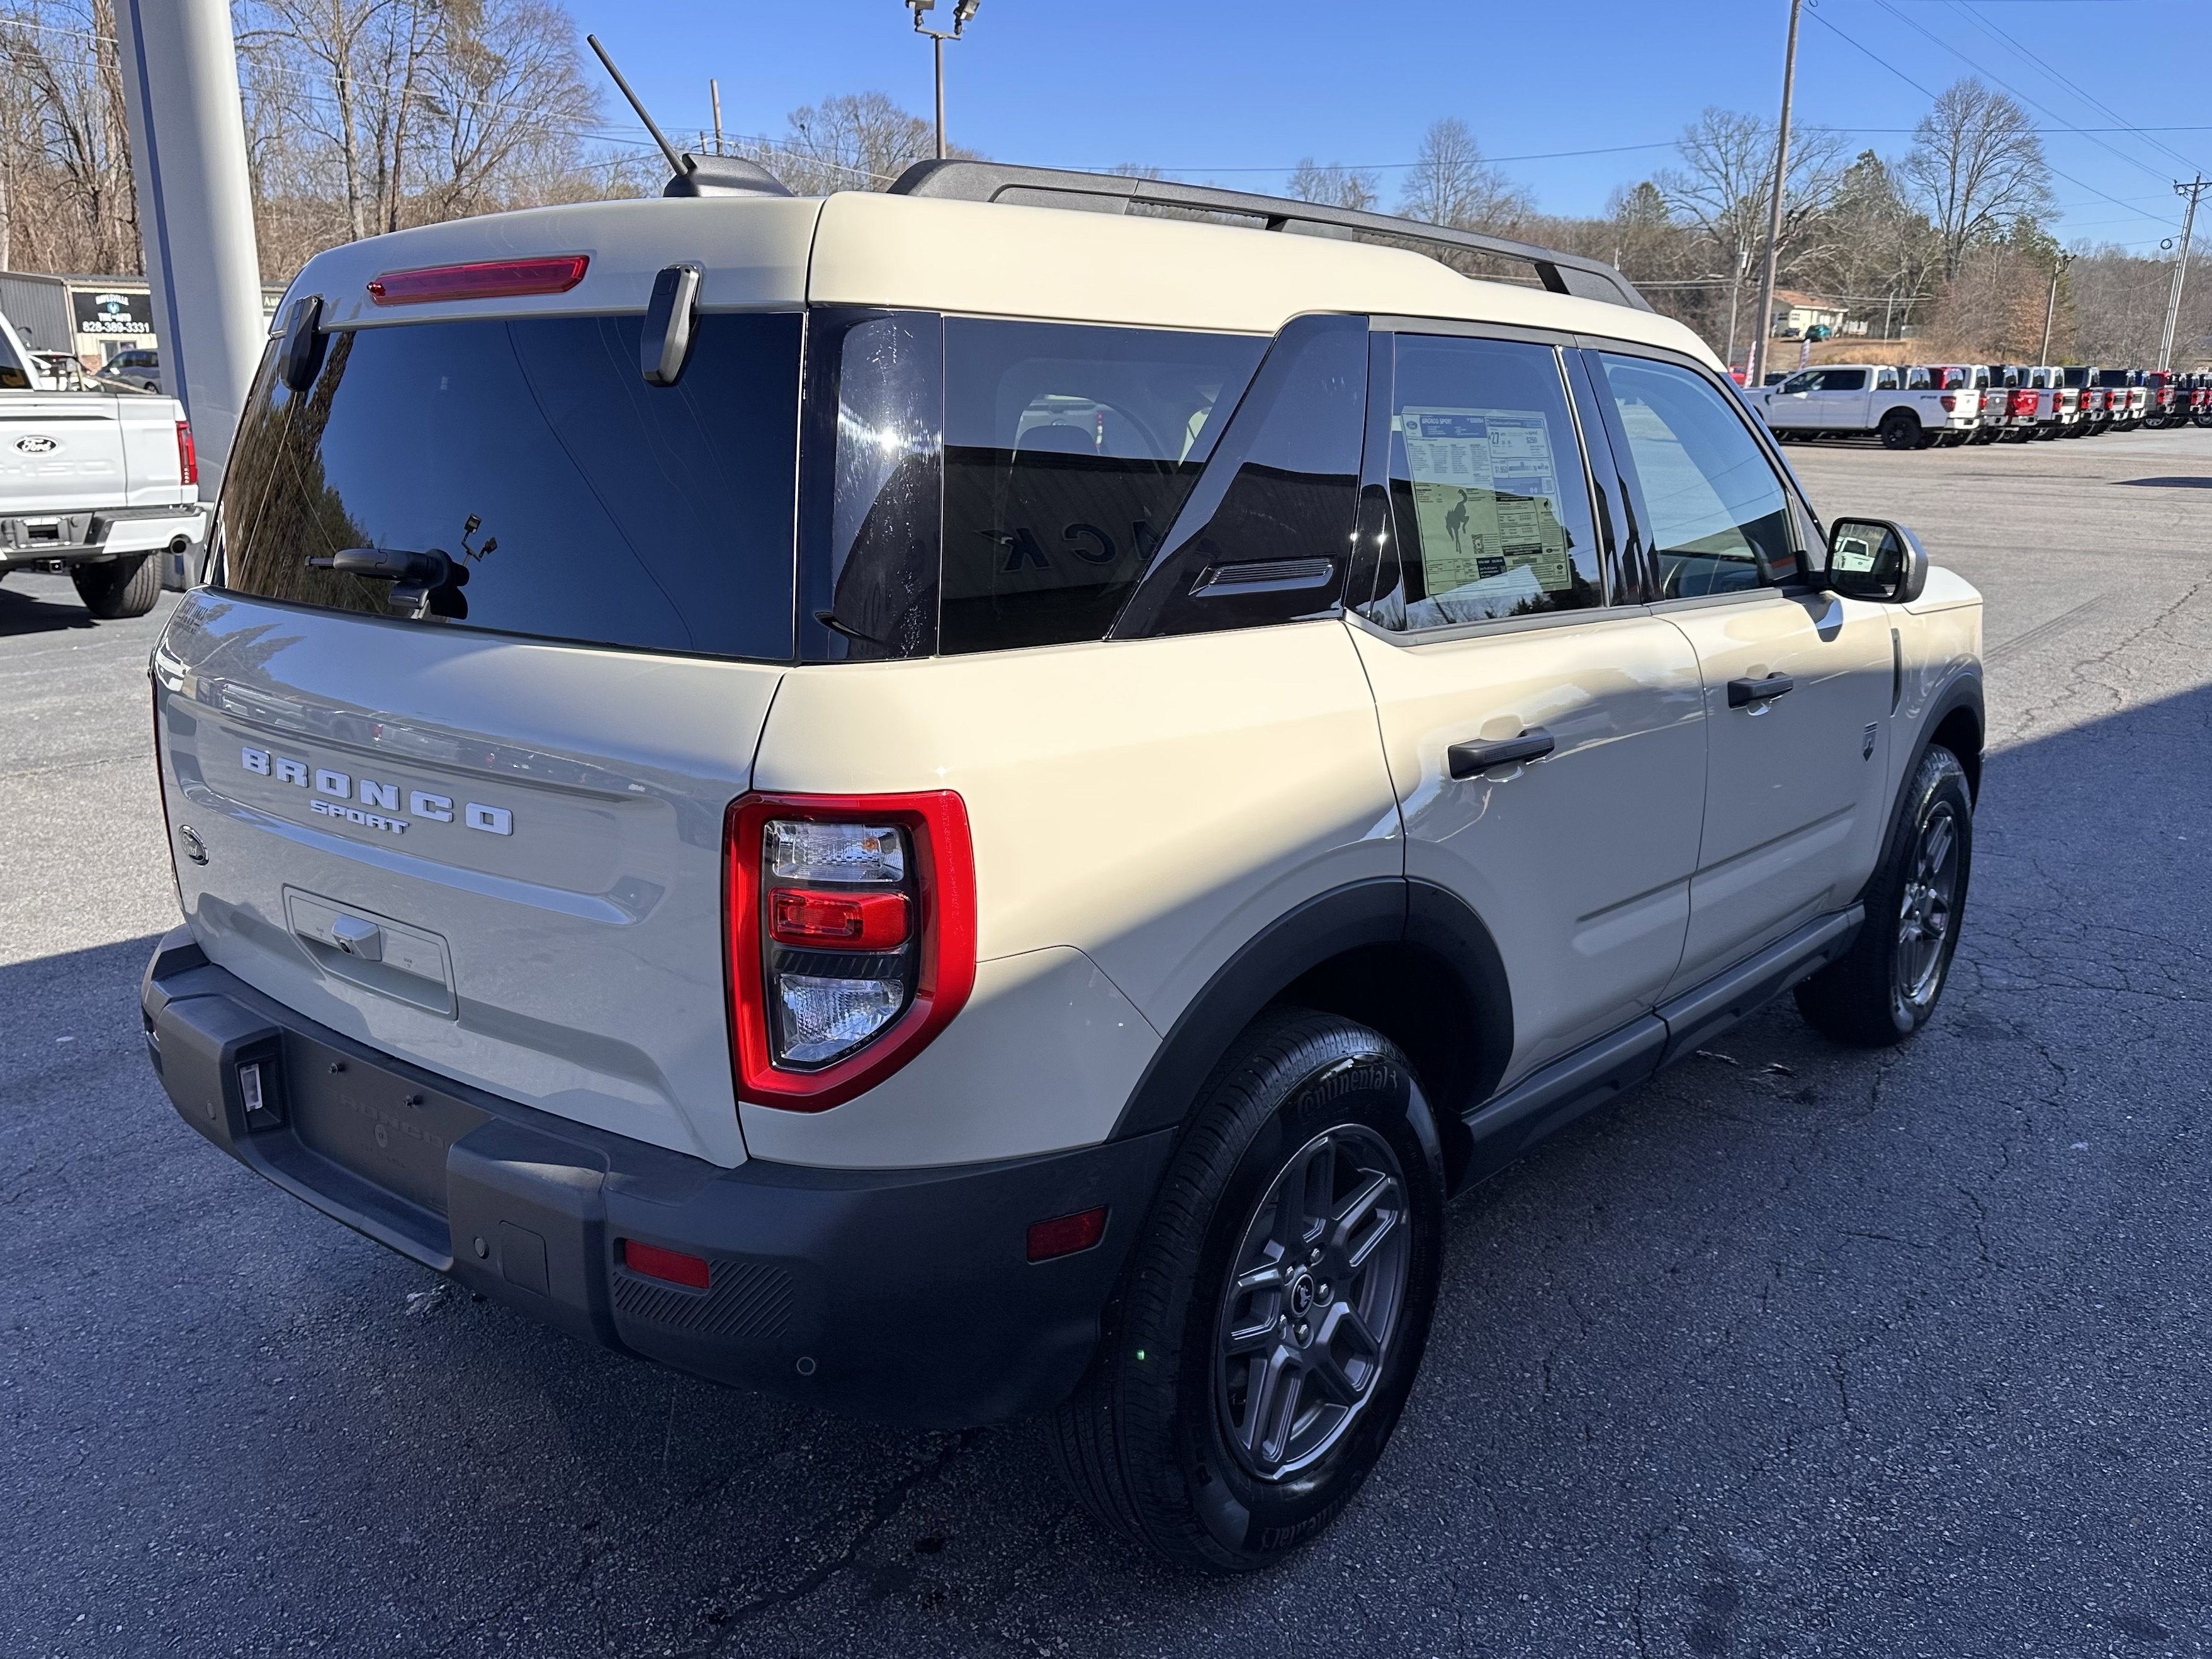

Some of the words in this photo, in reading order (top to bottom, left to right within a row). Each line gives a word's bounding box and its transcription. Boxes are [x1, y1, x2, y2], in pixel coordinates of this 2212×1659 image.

[82, 321, 150, 333] 828-389-3331
[21, 437, 52, 451] Ford
[242, 746, 513, 836] BRONCO
[310, 799, 409, 834] SPORT
[1297, 1064, 1389, 1122] Continental
